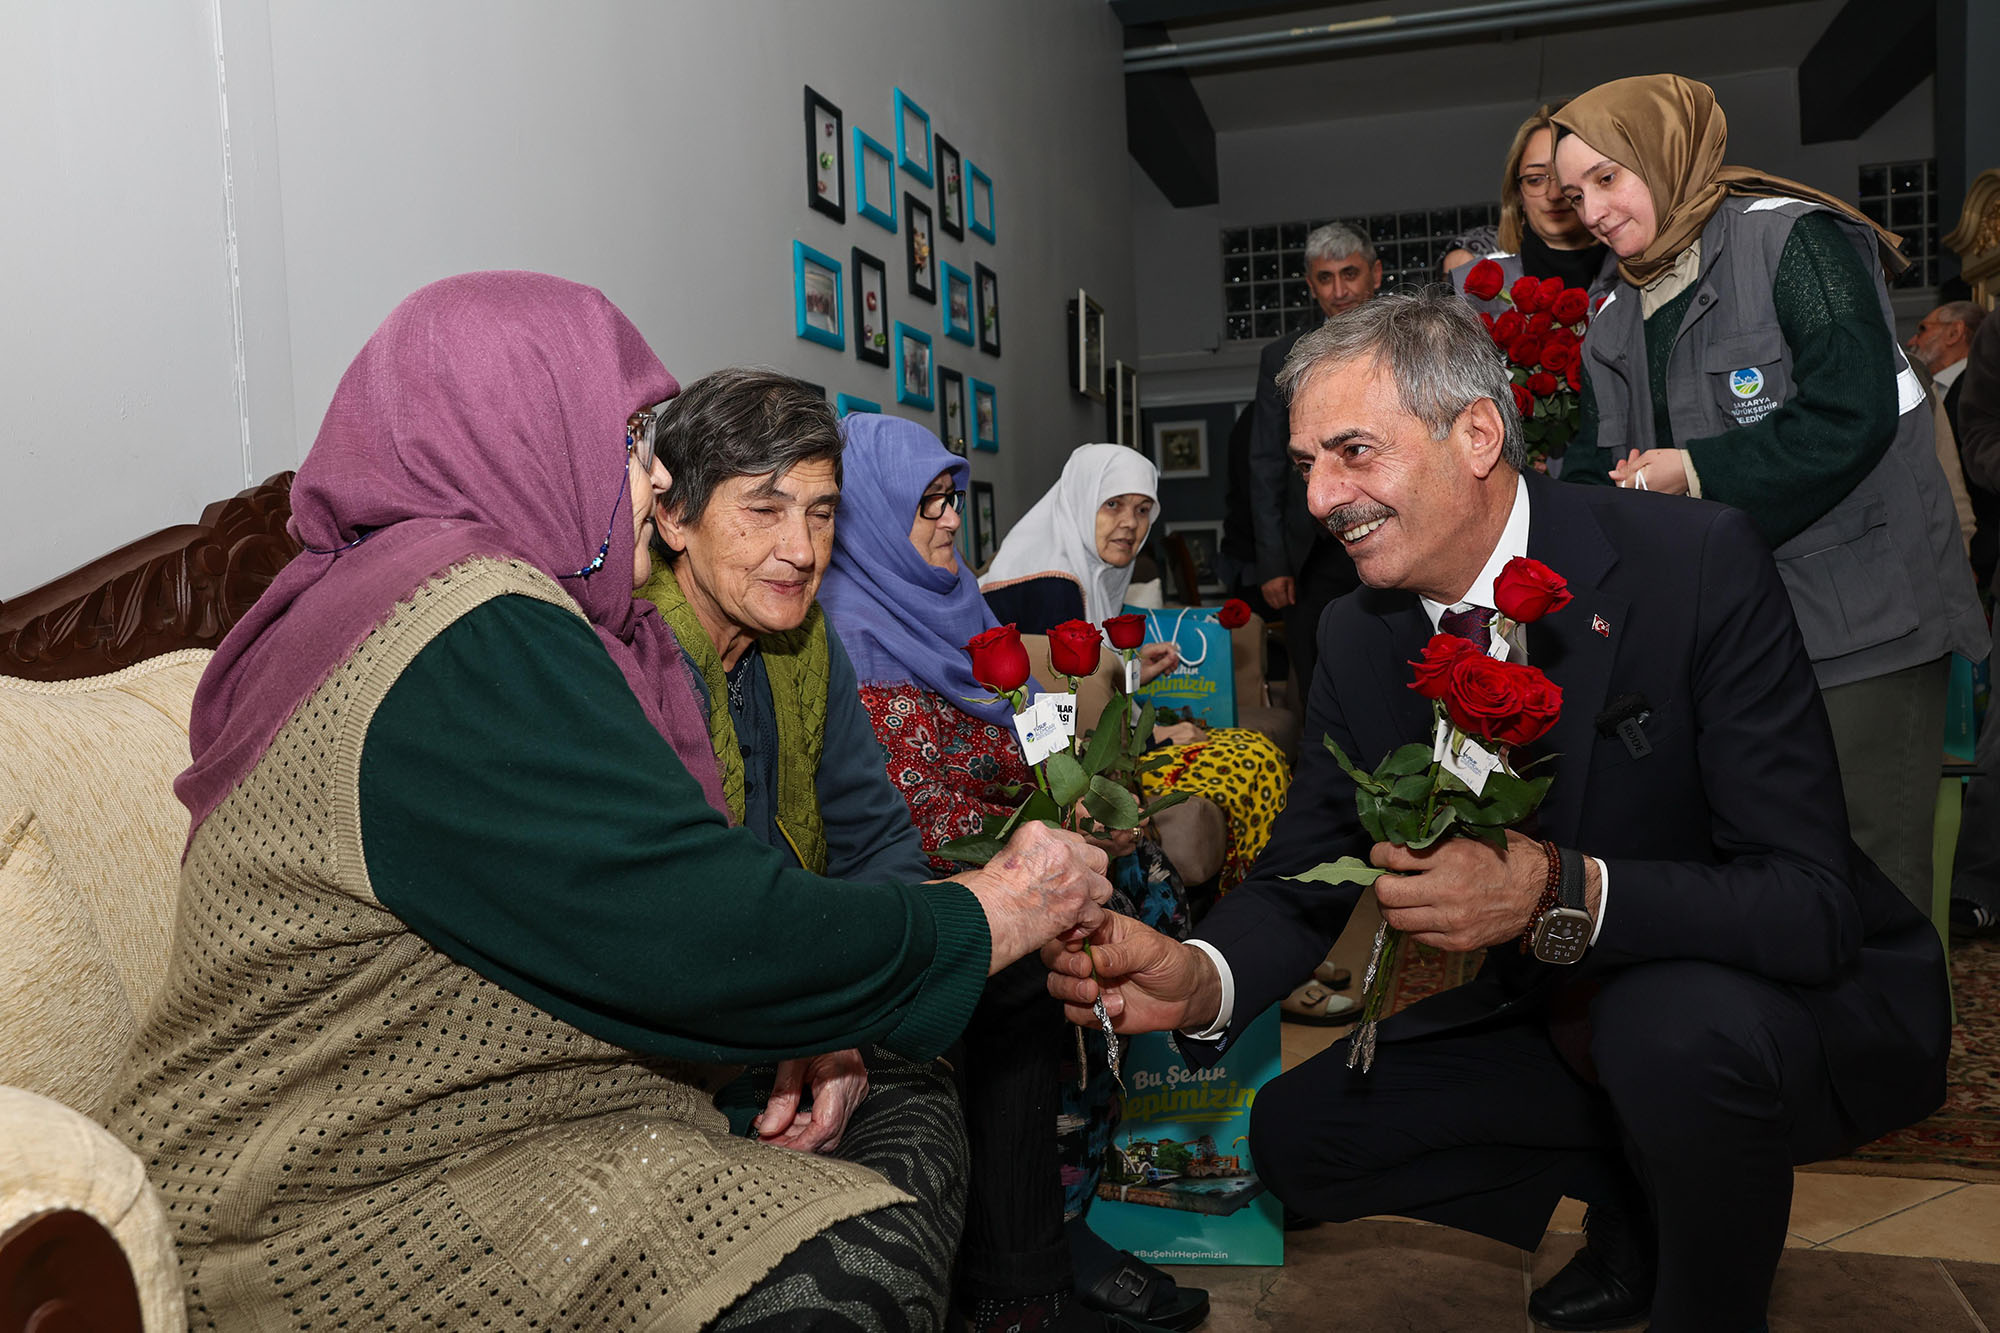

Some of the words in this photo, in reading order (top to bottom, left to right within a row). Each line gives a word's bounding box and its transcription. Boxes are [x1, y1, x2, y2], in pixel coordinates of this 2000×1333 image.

[1055, 704, 1073, 713] ILAR
[1132, 1069, 1162, 1090] Bu
[1133, 1249, 1228, 1259] #BuŞehirHepimizin
